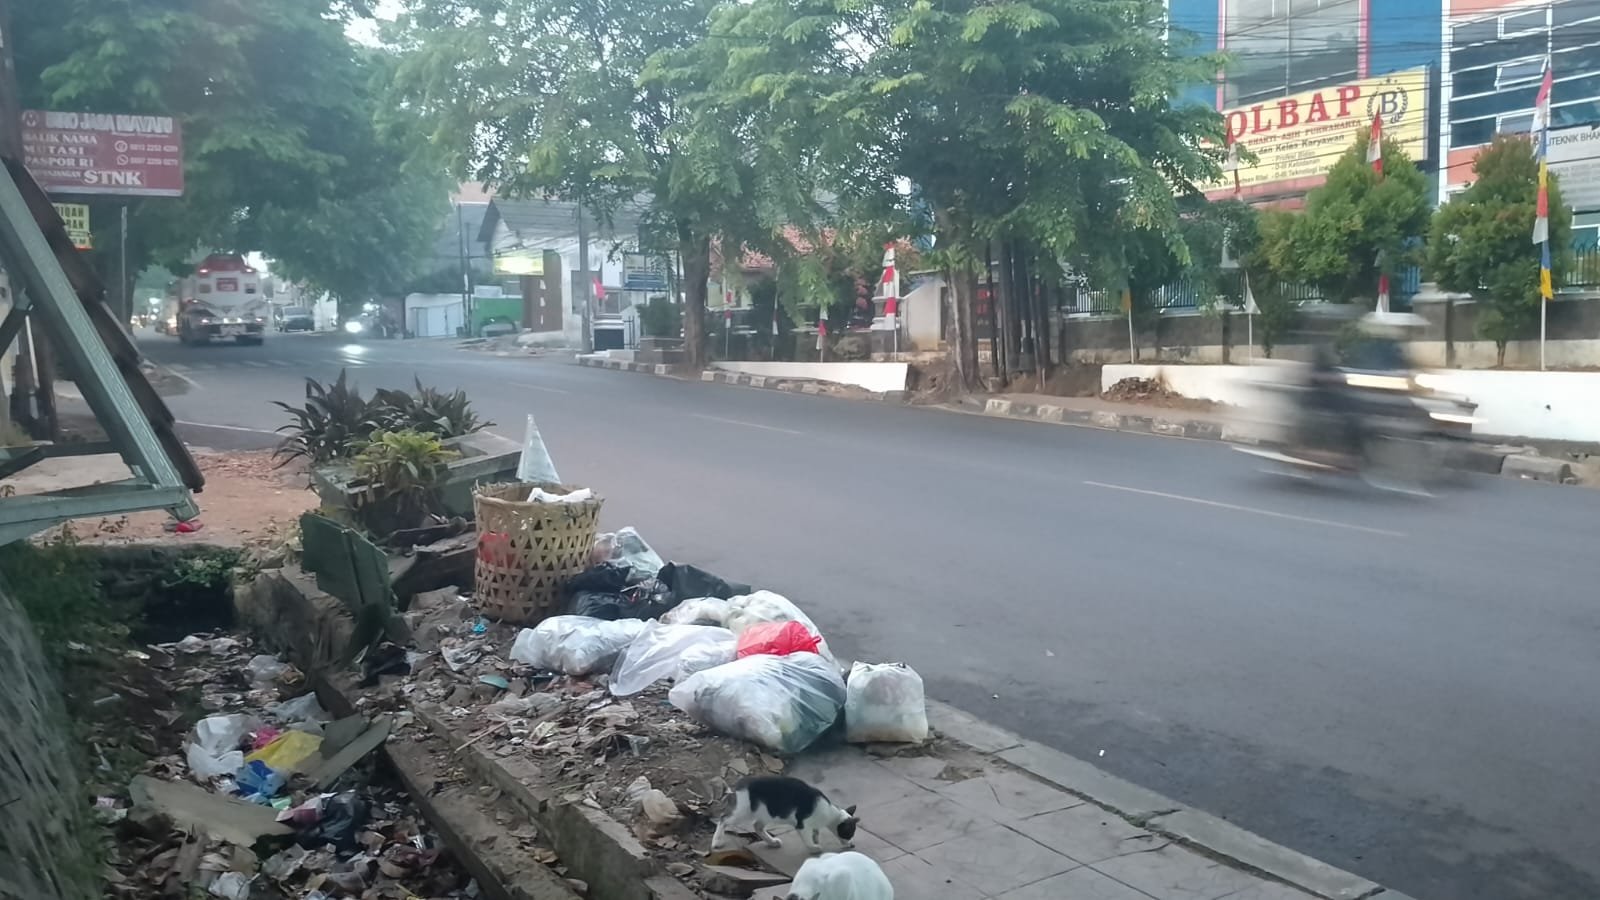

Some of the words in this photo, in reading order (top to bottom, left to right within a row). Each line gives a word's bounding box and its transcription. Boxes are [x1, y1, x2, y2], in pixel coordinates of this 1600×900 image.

[1201, 85, 1361, 143] OLBAP
[62, 134, 98, 144] NAMA
[24, 145, 85, 155] MUTASI
[79, 157, 94, 168] RI
[84, 170, 142, 185] STNK
